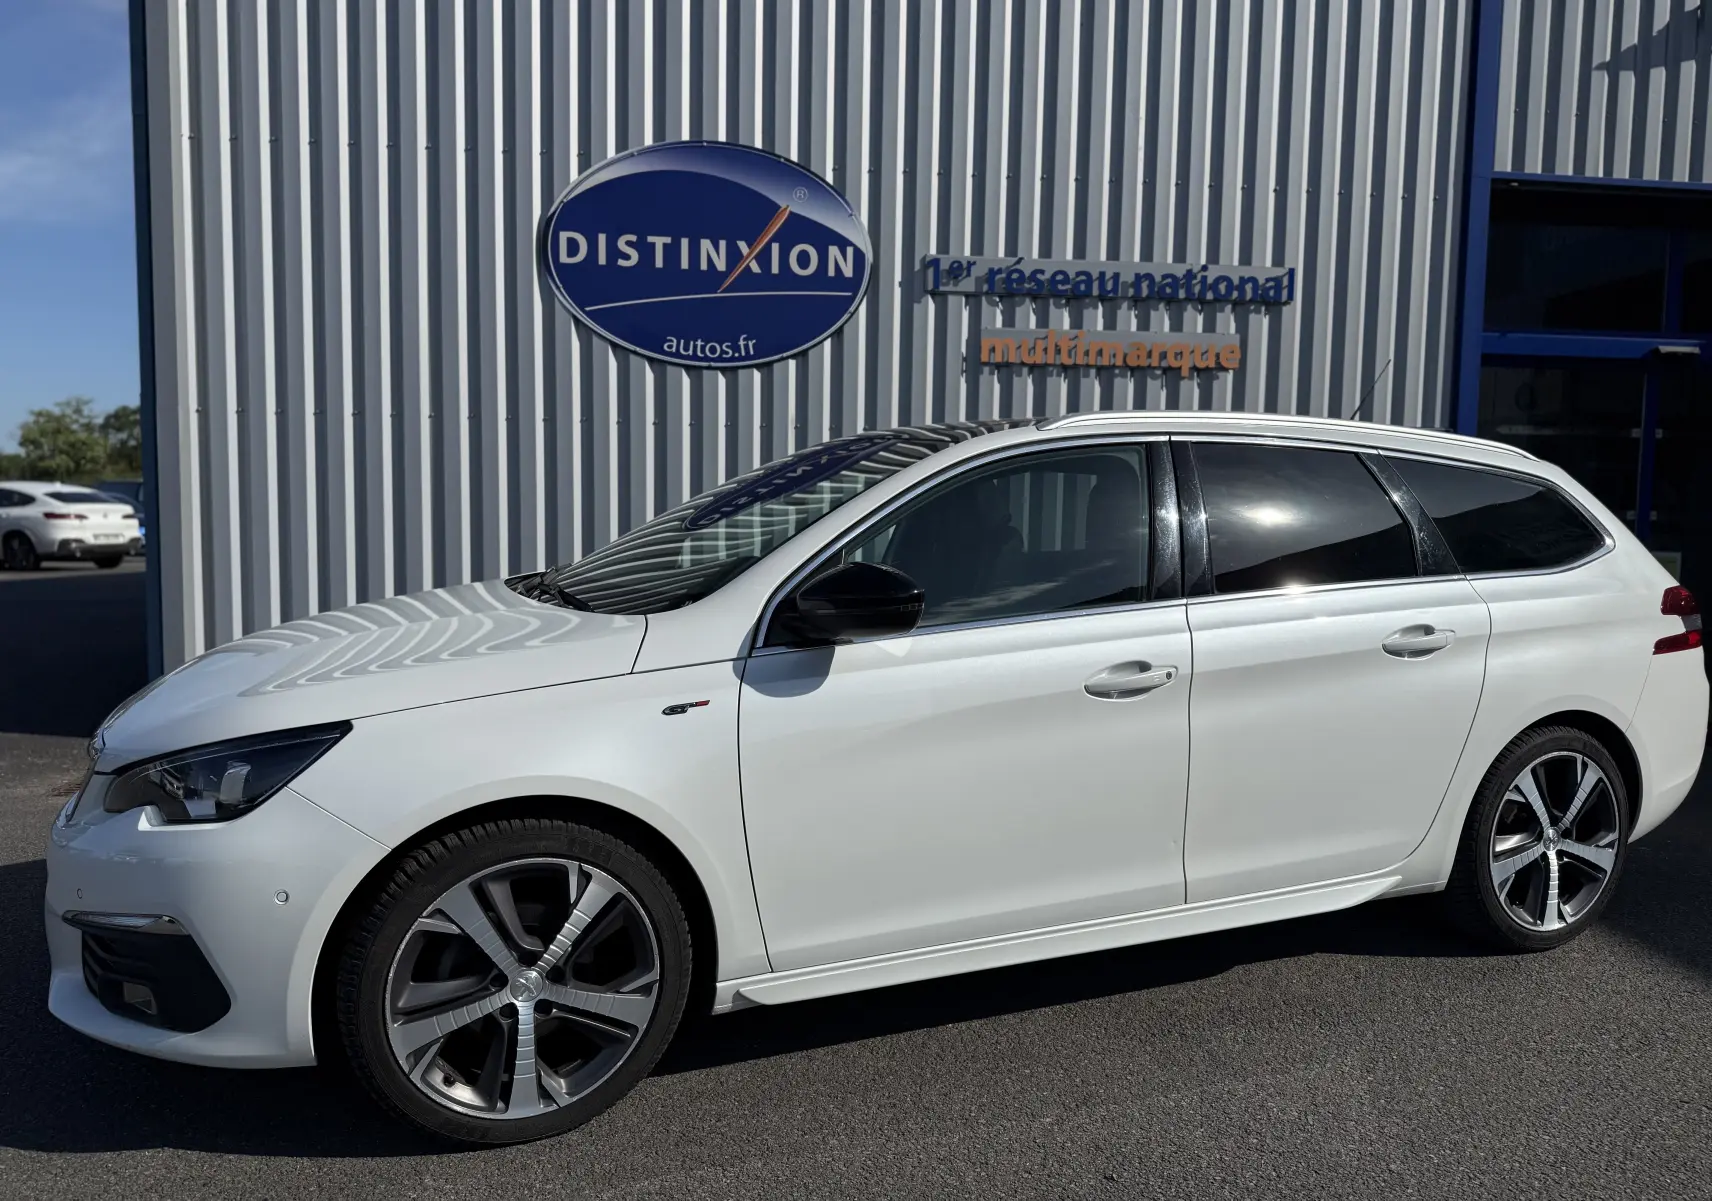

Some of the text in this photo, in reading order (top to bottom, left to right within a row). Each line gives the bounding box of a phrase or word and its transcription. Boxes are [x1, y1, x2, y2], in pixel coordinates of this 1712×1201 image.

[558, 230, 854, 278] DISTINXION
[926, 257, 1295, 301] 1er réseau national
[663, 333, 757, 358] autos.fr
[980, 329, 1241, 377] multimarque
